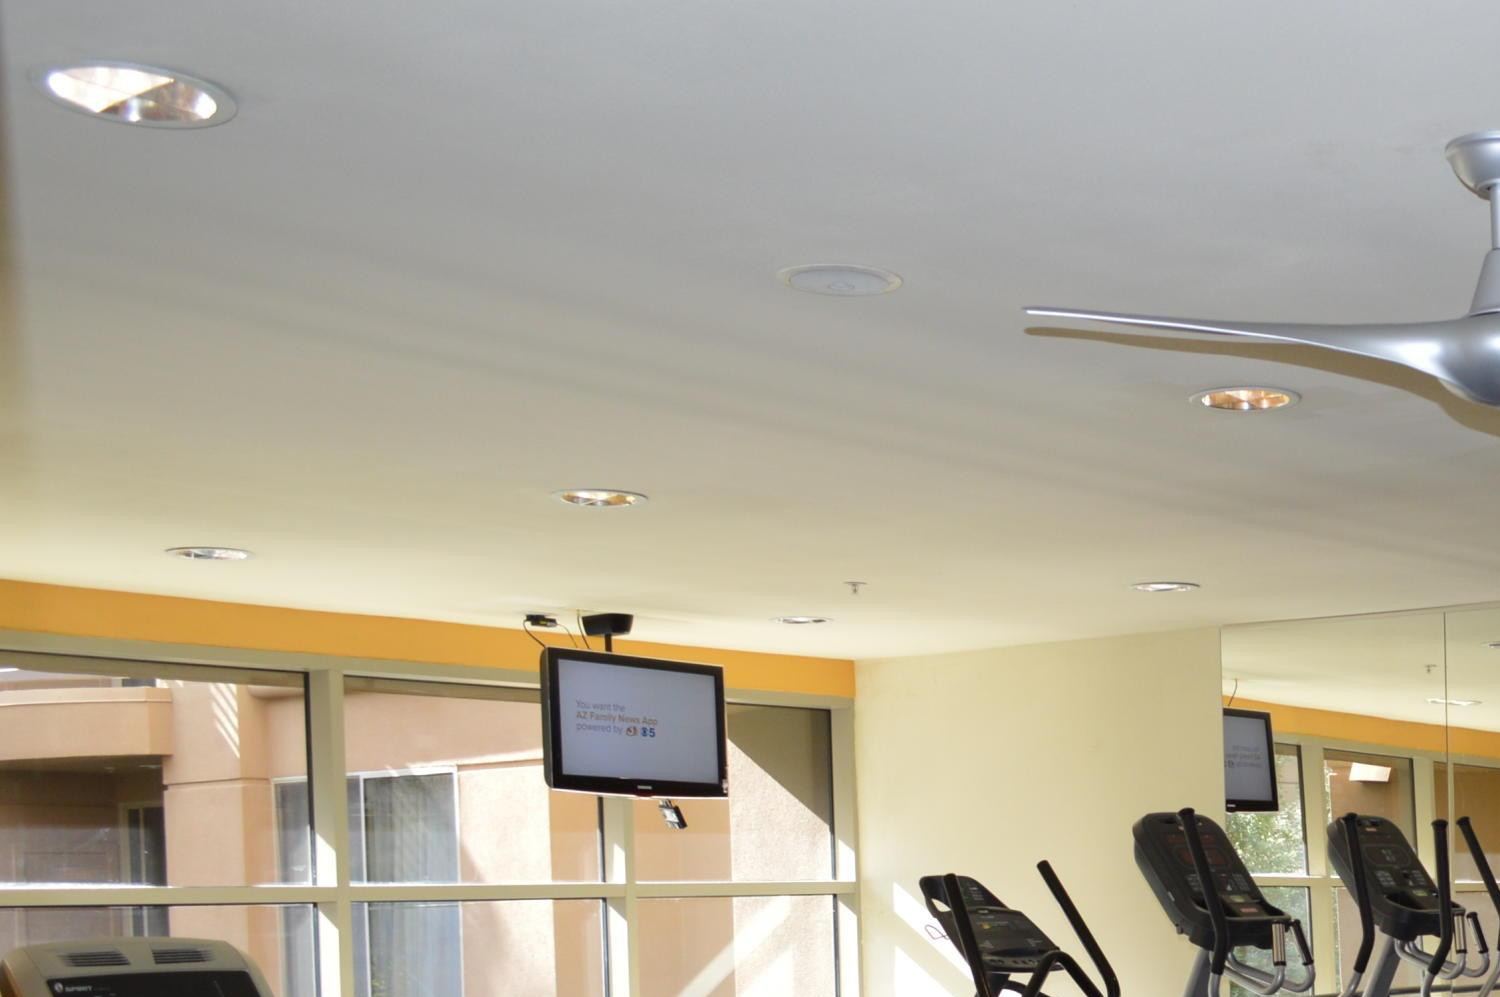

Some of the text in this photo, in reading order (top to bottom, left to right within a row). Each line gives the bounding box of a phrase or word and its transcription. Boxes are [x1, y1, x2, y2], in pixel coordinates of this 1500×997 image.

[576, 711, 588, 719] AZ
[590, 712, 616, 723] Family
[618, 714, 640, 723] News
